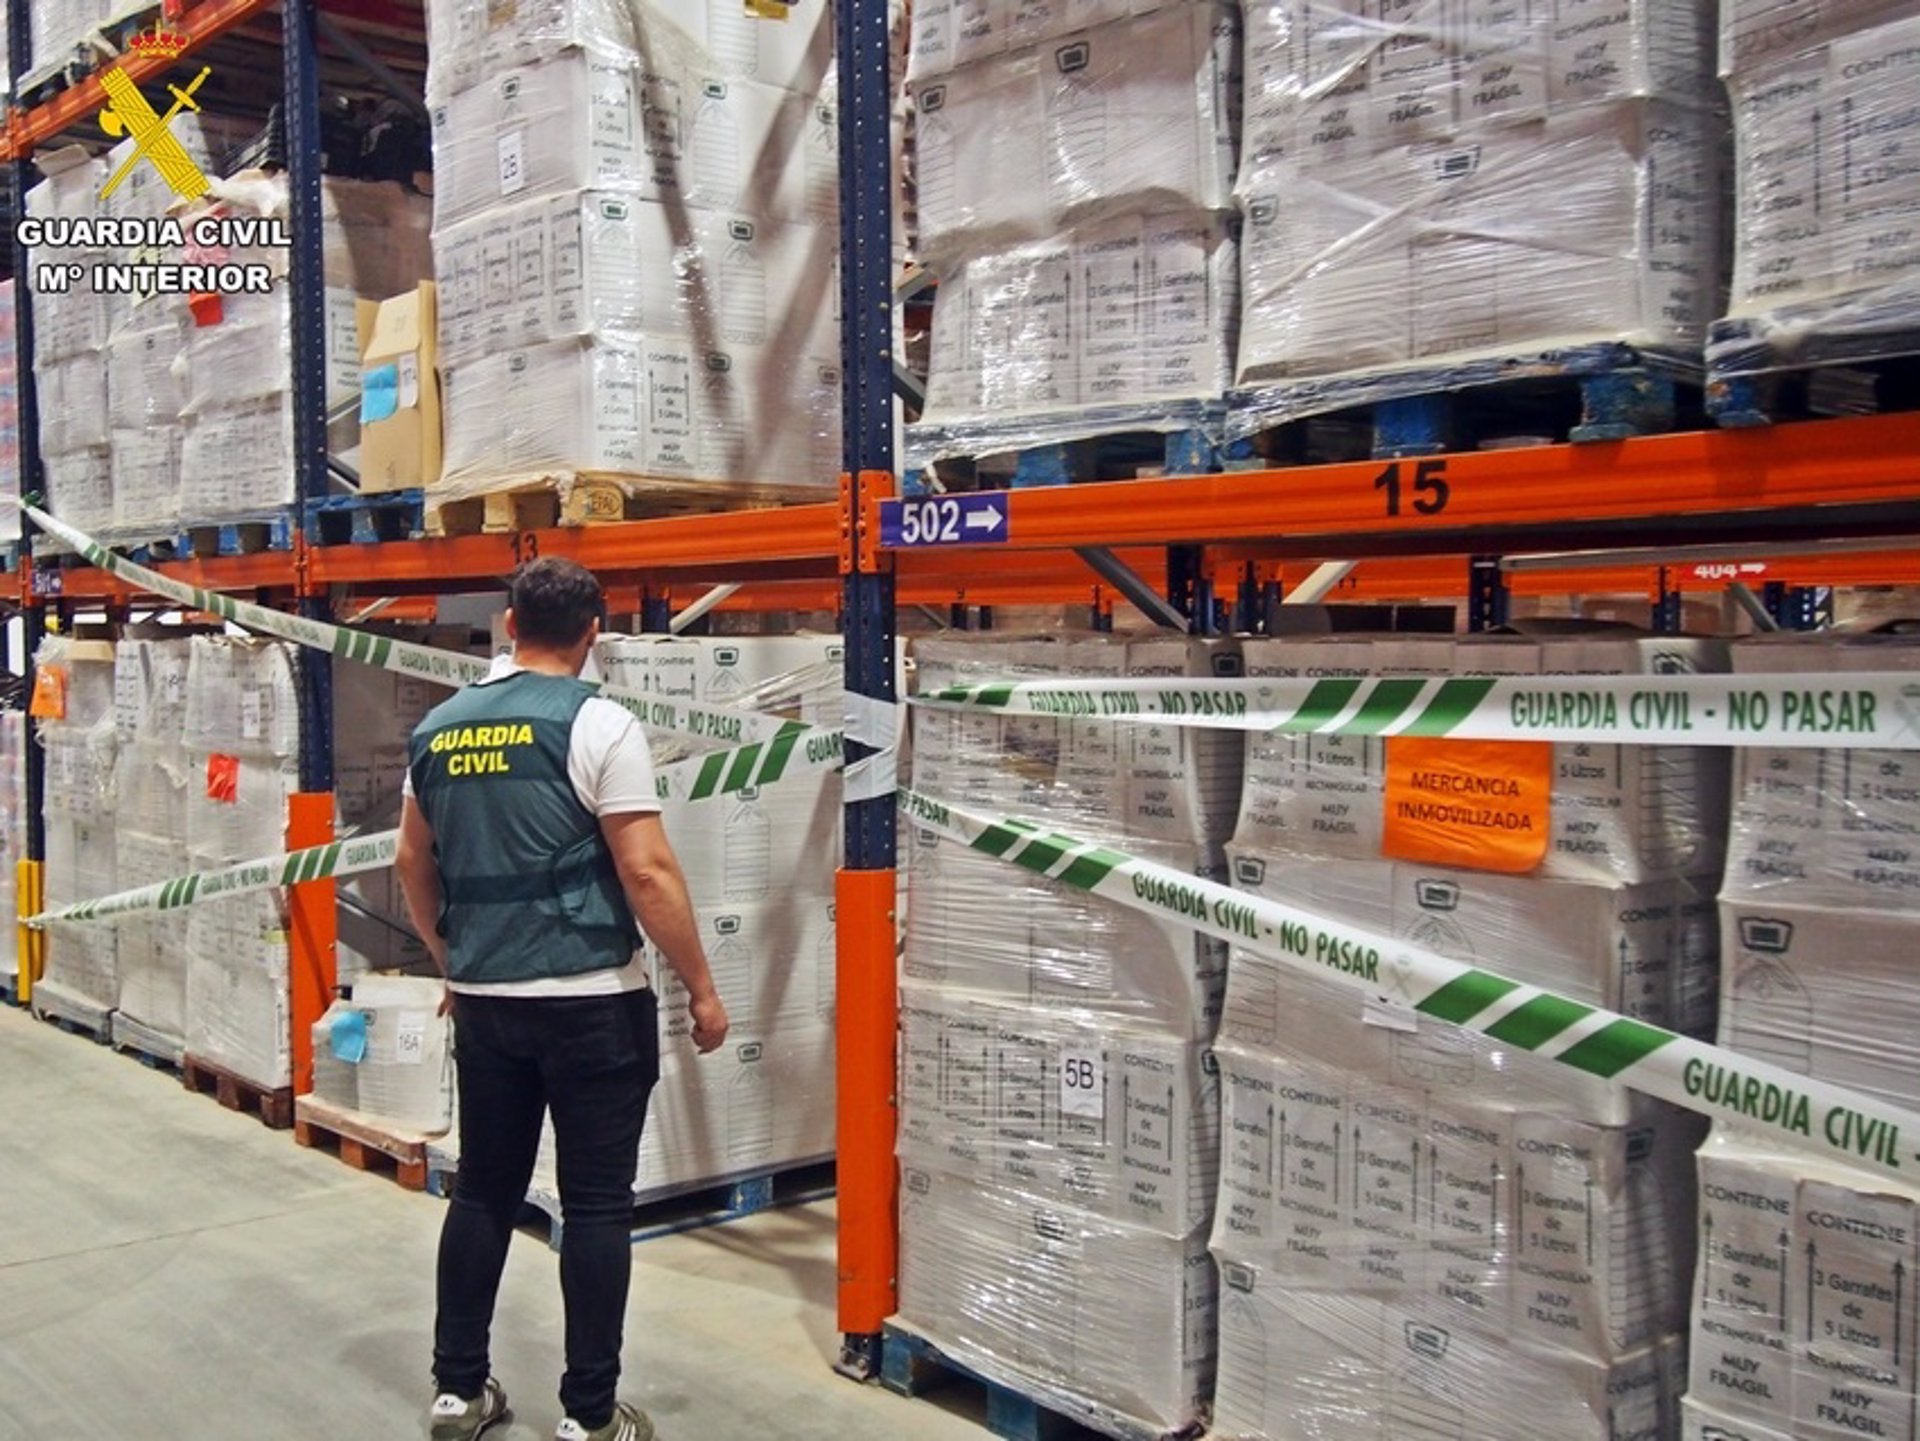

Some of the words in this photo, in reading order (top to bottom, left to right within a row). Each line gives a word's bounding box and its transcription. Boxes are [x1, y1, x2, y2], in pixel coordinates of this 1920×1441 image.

[1374, 461, 1450, 516] 15
[902, 500, 960, 543] 502
[1159, 691, 1186, 714] NO
[1190, 691, 1247, 716] PASAR
[1511, 691, 1617, 730] GUARDIA
[1630, 692, 1692, 731] CIVIL
[1727, 691, 1768, 732] NO
[1781, 691, 1876, 733] PASAR
[652, 702, 676, 730] CIVIL
[687, 709, 705, 735] NO
[707, 712, 741, 743] PASAR
[430, 724, 533, 754] GUARDIA
[448, 751, 510, 777] CIVIL
[1411, 772, 1520, 797] MERCANCIA
[1398, 803, 1533, 831] INMOVILIZADA
[1132, 871, 1207, 922] GUARDIA
[1214, 897, 1259, 941] CIVIL
[1280, 925, 1308, 956] NO
[1316, 932, 1379, 983] PASAR
[1065, 1058, 1094, 1089] 5B
[1683, 1057, 1811, 1137] GUARDIA
[1824, 1106, 1901, 1168] CIVIL
[1704, 1183, 1789, 1215] CONTIENE
[1732, 1272, 1750, 1288] de
[1815, 1269, 1824, 1286] 3
[1843, 1303, 1863, 1320] de
[1825, 1320, 1834, 1336] 5
[1839, 1324, 1880, 1349] Litros
[1721, 1355, 1761, 1374] MUY
[1831, 1387, 1874, 1410] MUY
